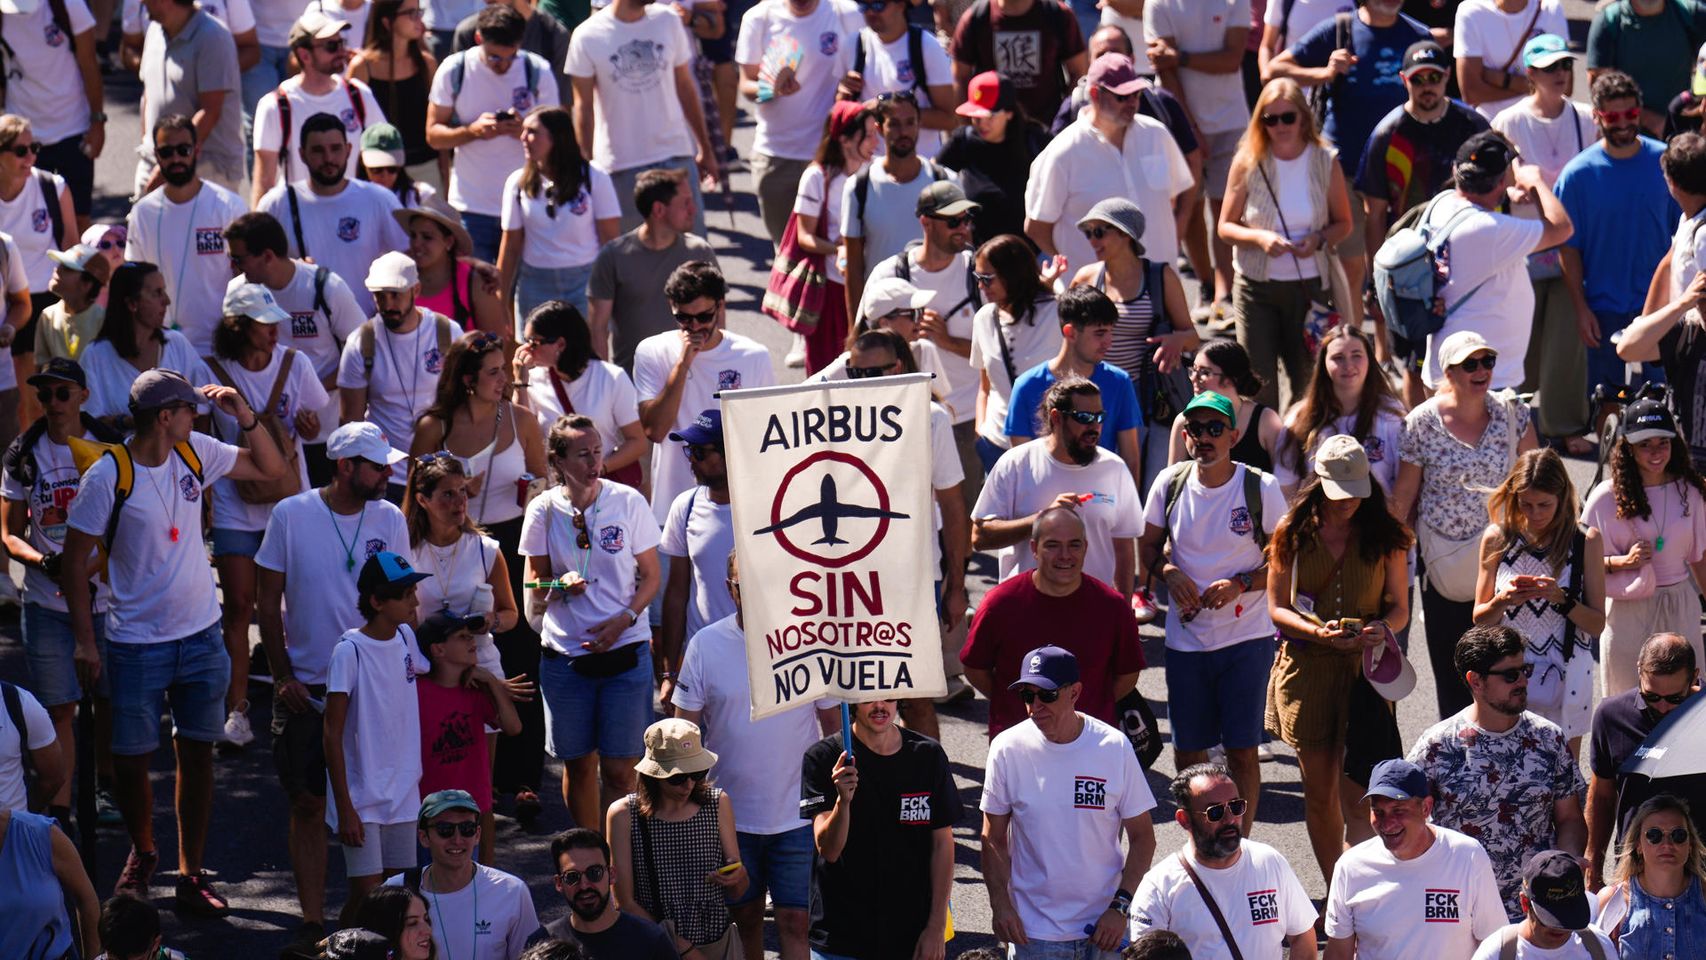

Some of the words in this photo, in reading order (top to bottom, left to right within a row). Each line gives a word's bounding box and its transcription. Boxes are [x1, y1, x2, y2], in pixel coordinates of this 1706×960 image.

[196, 231, 223, 241] FCK
[291, 315, 315, 325] FCK
[760, 405, 903, 454] AIRBUS
[789, 571, 883, 618] SIN
[766, 621, 913, 659] NOSOTR@S
[774, 663, 810, 704] NO
[816, 656, 914, 691] VUELA
[1074, 780, 1106, 795] FCK
[900, 796, 930, 810] FCK
[1074, 792, 1105, 806] BRM
[899, 808, 931, 821] BRM
[1248, 894, 1277, 909] FCK
[1425, 893, 1459, 906] FCK
[1250, 906, 1279, 922] BRM
[1425, 906, 1459, 919] BRM
